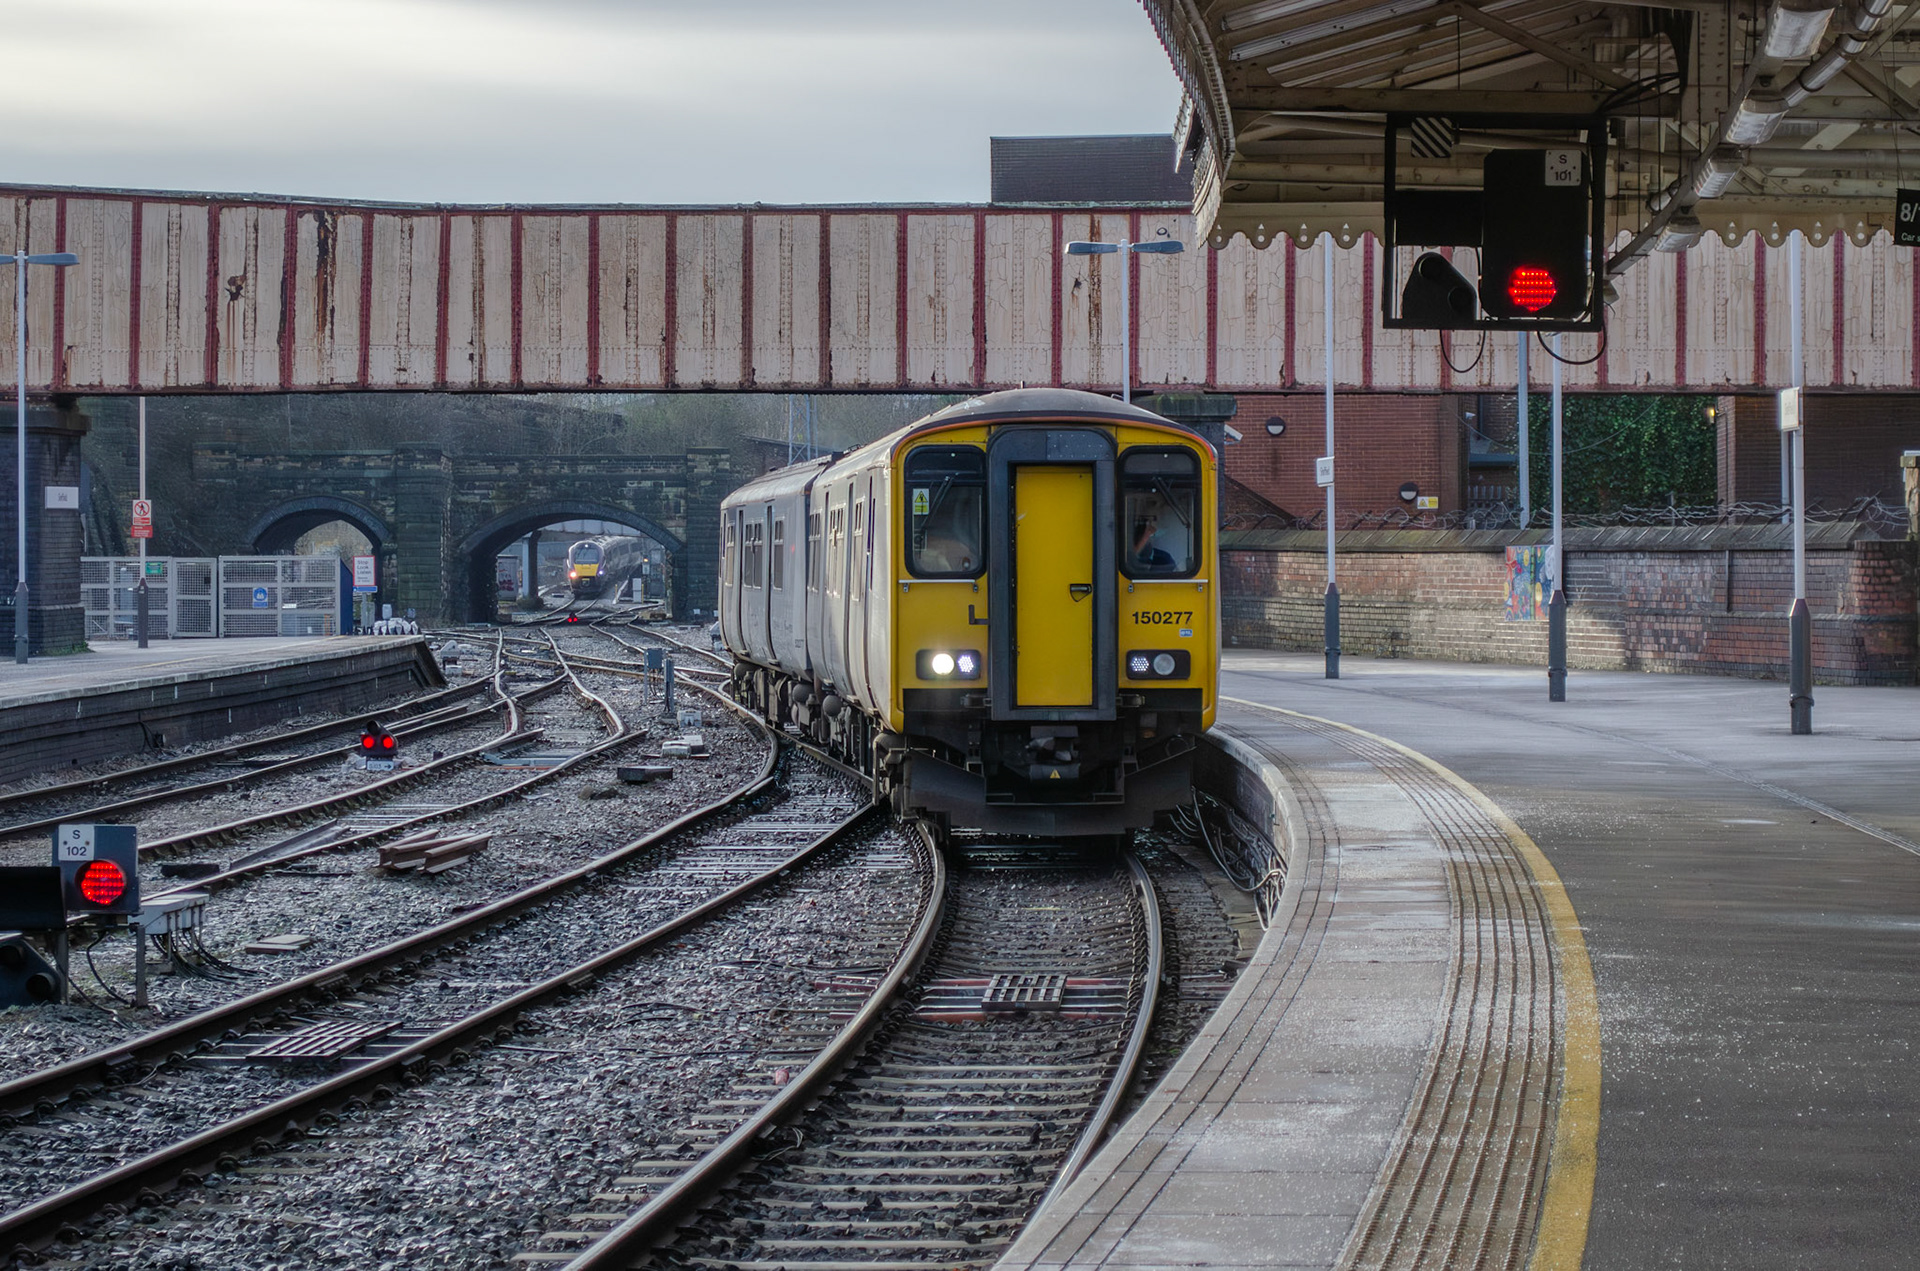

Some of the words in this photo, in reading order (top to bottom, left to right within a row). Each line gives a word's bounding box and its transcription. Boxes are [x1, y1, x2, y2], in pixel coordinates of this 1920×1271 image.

[1559, 154, 1567, 164] S
[1555, 170, 1572, 182] 101
[1900, 202, 1920, 222] 8/
[1132, 611, 1193, 625] 150277
[72, 829, 81, 840] S
[66, 846, 87, 857] 102
